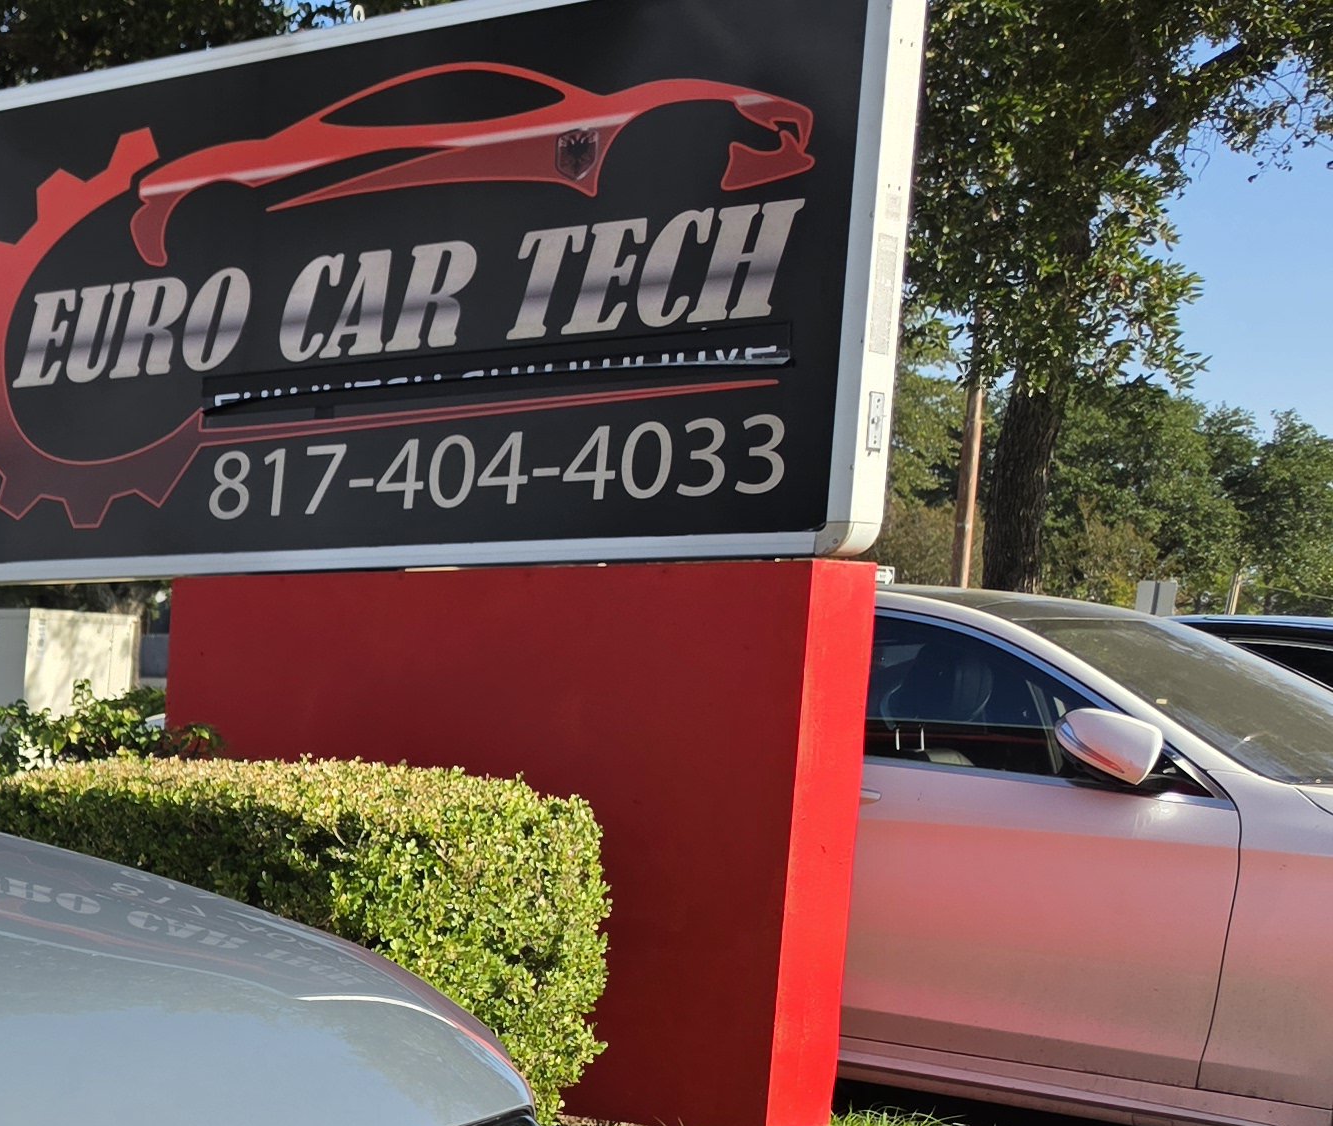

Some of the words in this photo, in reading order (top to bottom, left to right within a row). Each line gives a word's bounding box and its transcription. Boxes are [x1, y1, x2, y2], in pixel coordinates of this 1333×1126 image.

[12, 267, 251, 389] EURO
[279, 240, 478, 363] CAR
[506, 198, 806, 341] TECH
[208, 413, 786, 520] 817-404-4033
